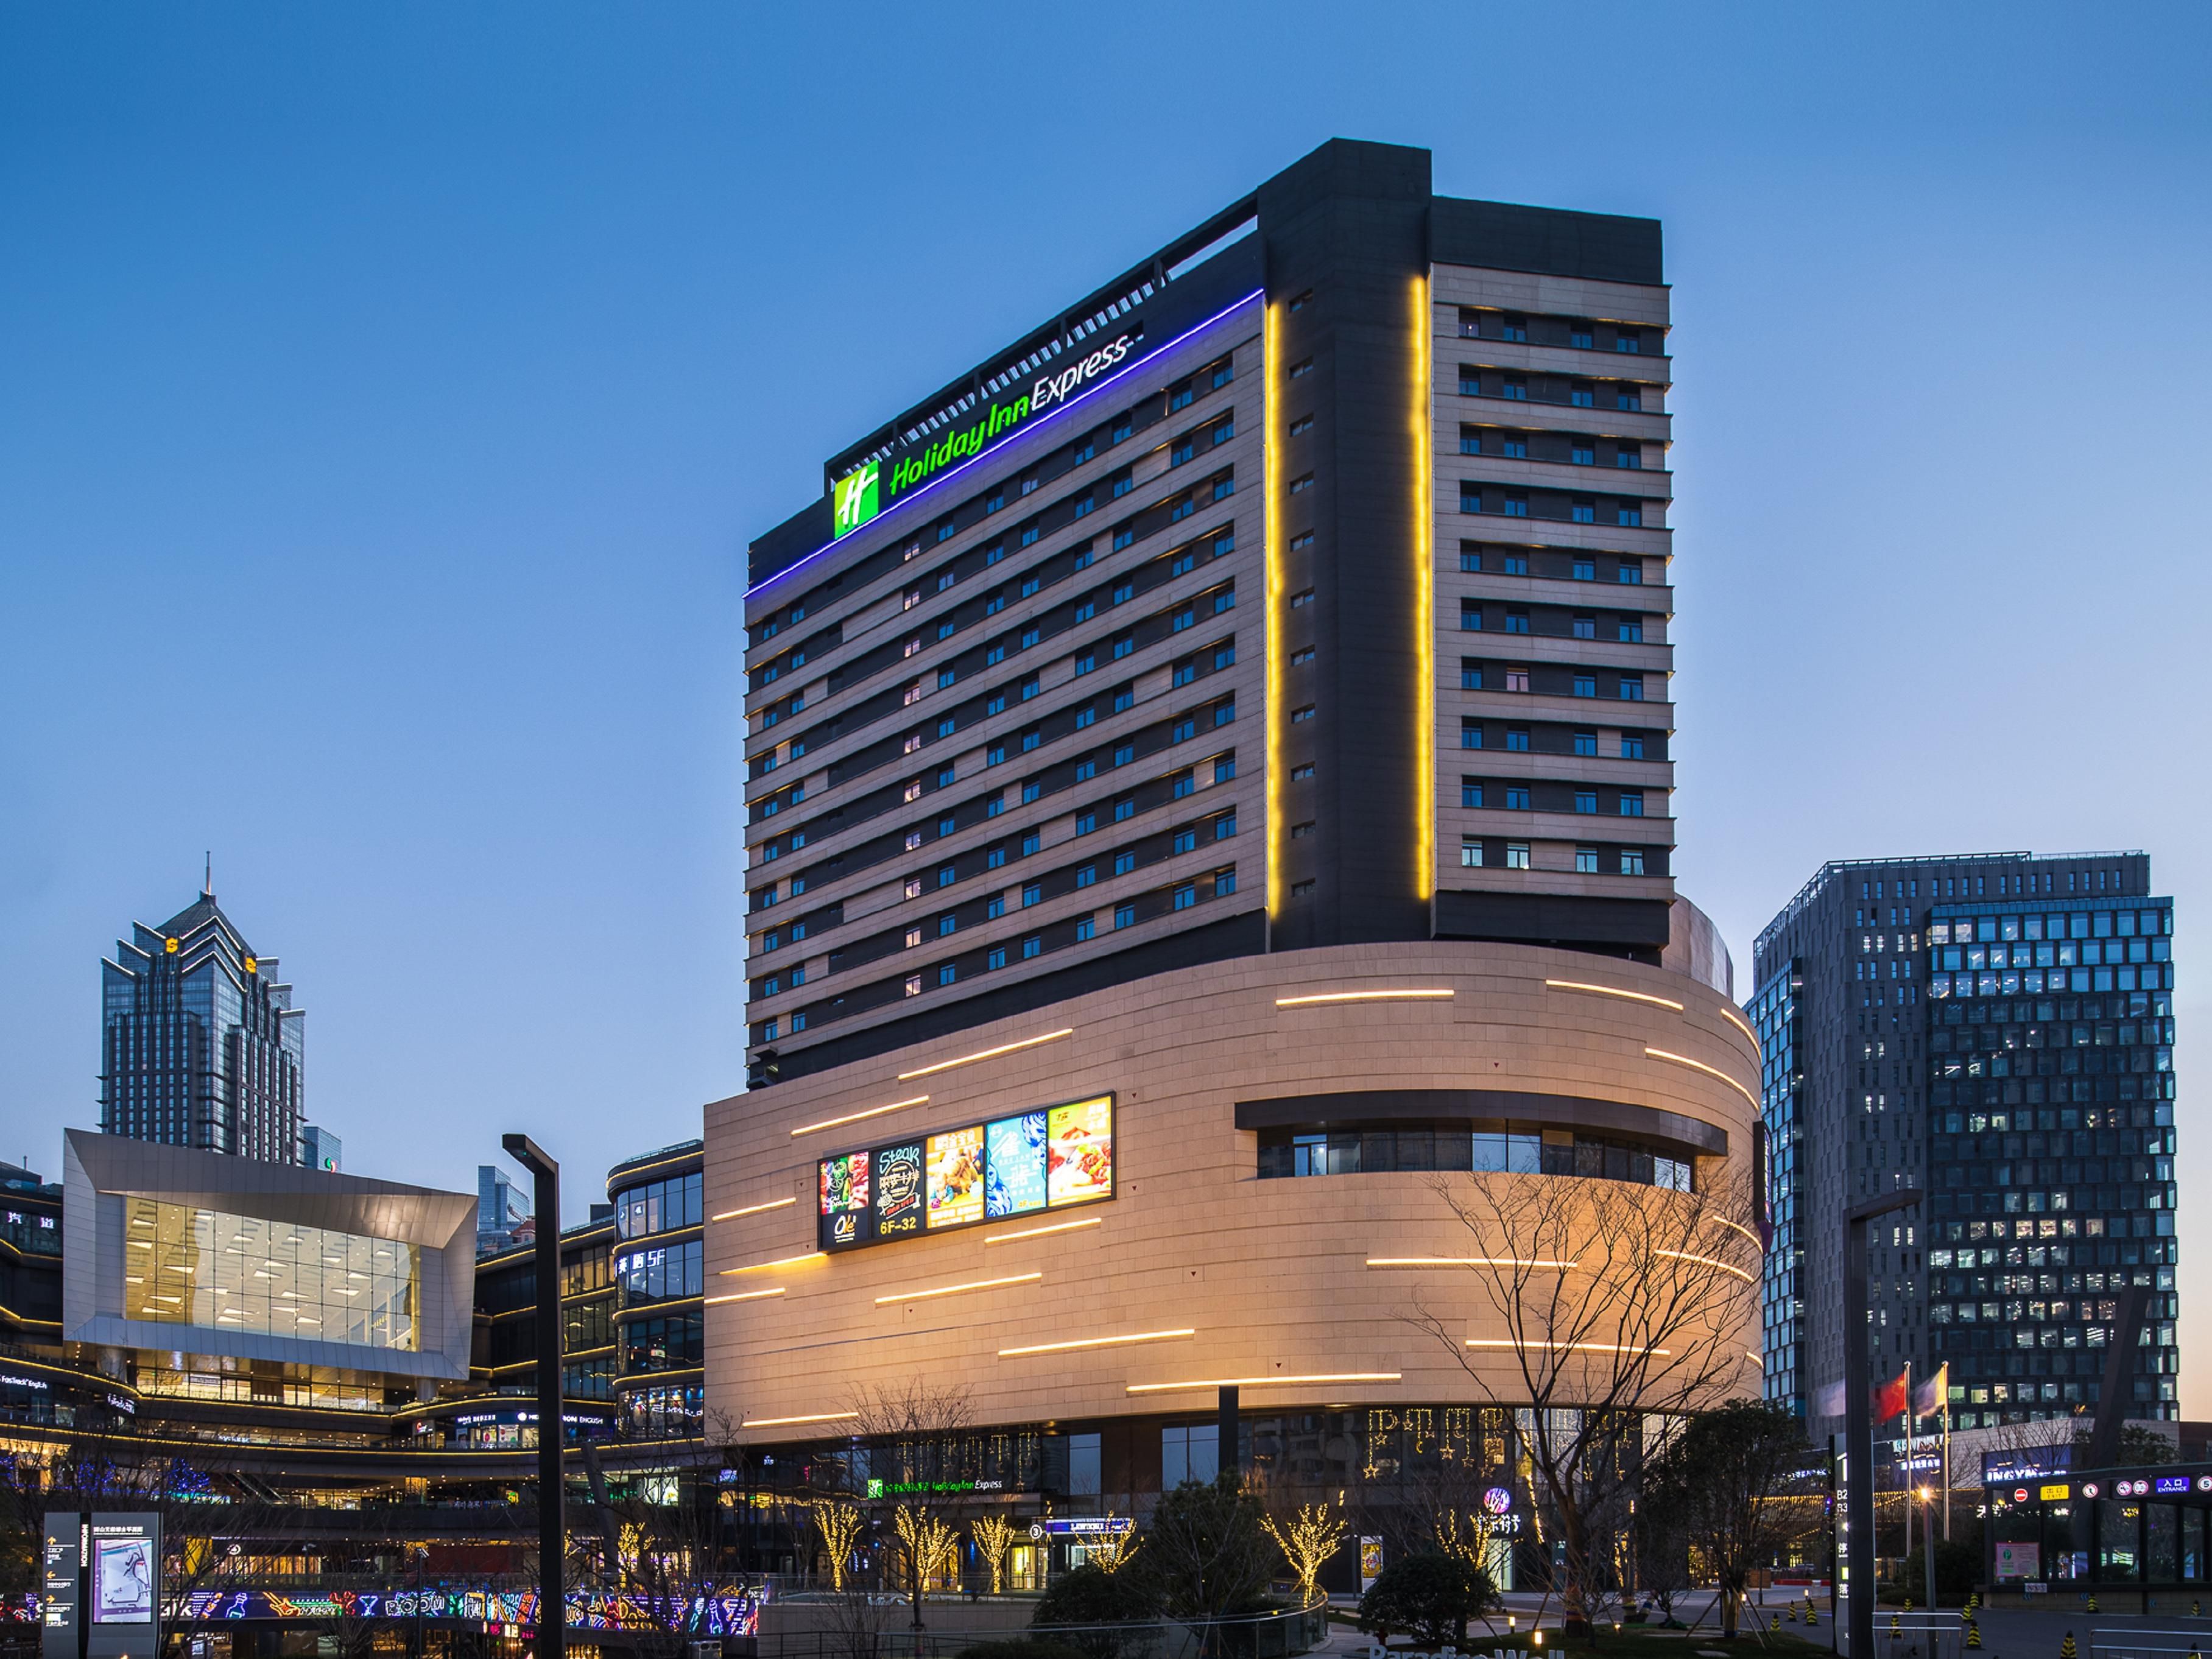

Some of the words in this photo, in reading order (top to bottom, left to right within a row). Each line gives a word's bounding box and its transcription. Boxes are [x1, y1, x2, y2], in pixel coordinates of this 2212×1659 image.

[890, 419, 987, 495] Holiday
[986, 395, 1029, 439] Inn
[1032, 334, 1128, 412] Express
[879, 1146, 920, 1174] Steak
[880, 1216, 917, 1235] 6F-32
[974, 1479, 1002, 1490] Express
[2163, 1478, 2183, 1487] 入口
[1836, 1489, 1848, 1501] B2
[160, 1600, 193, 1617] alk
